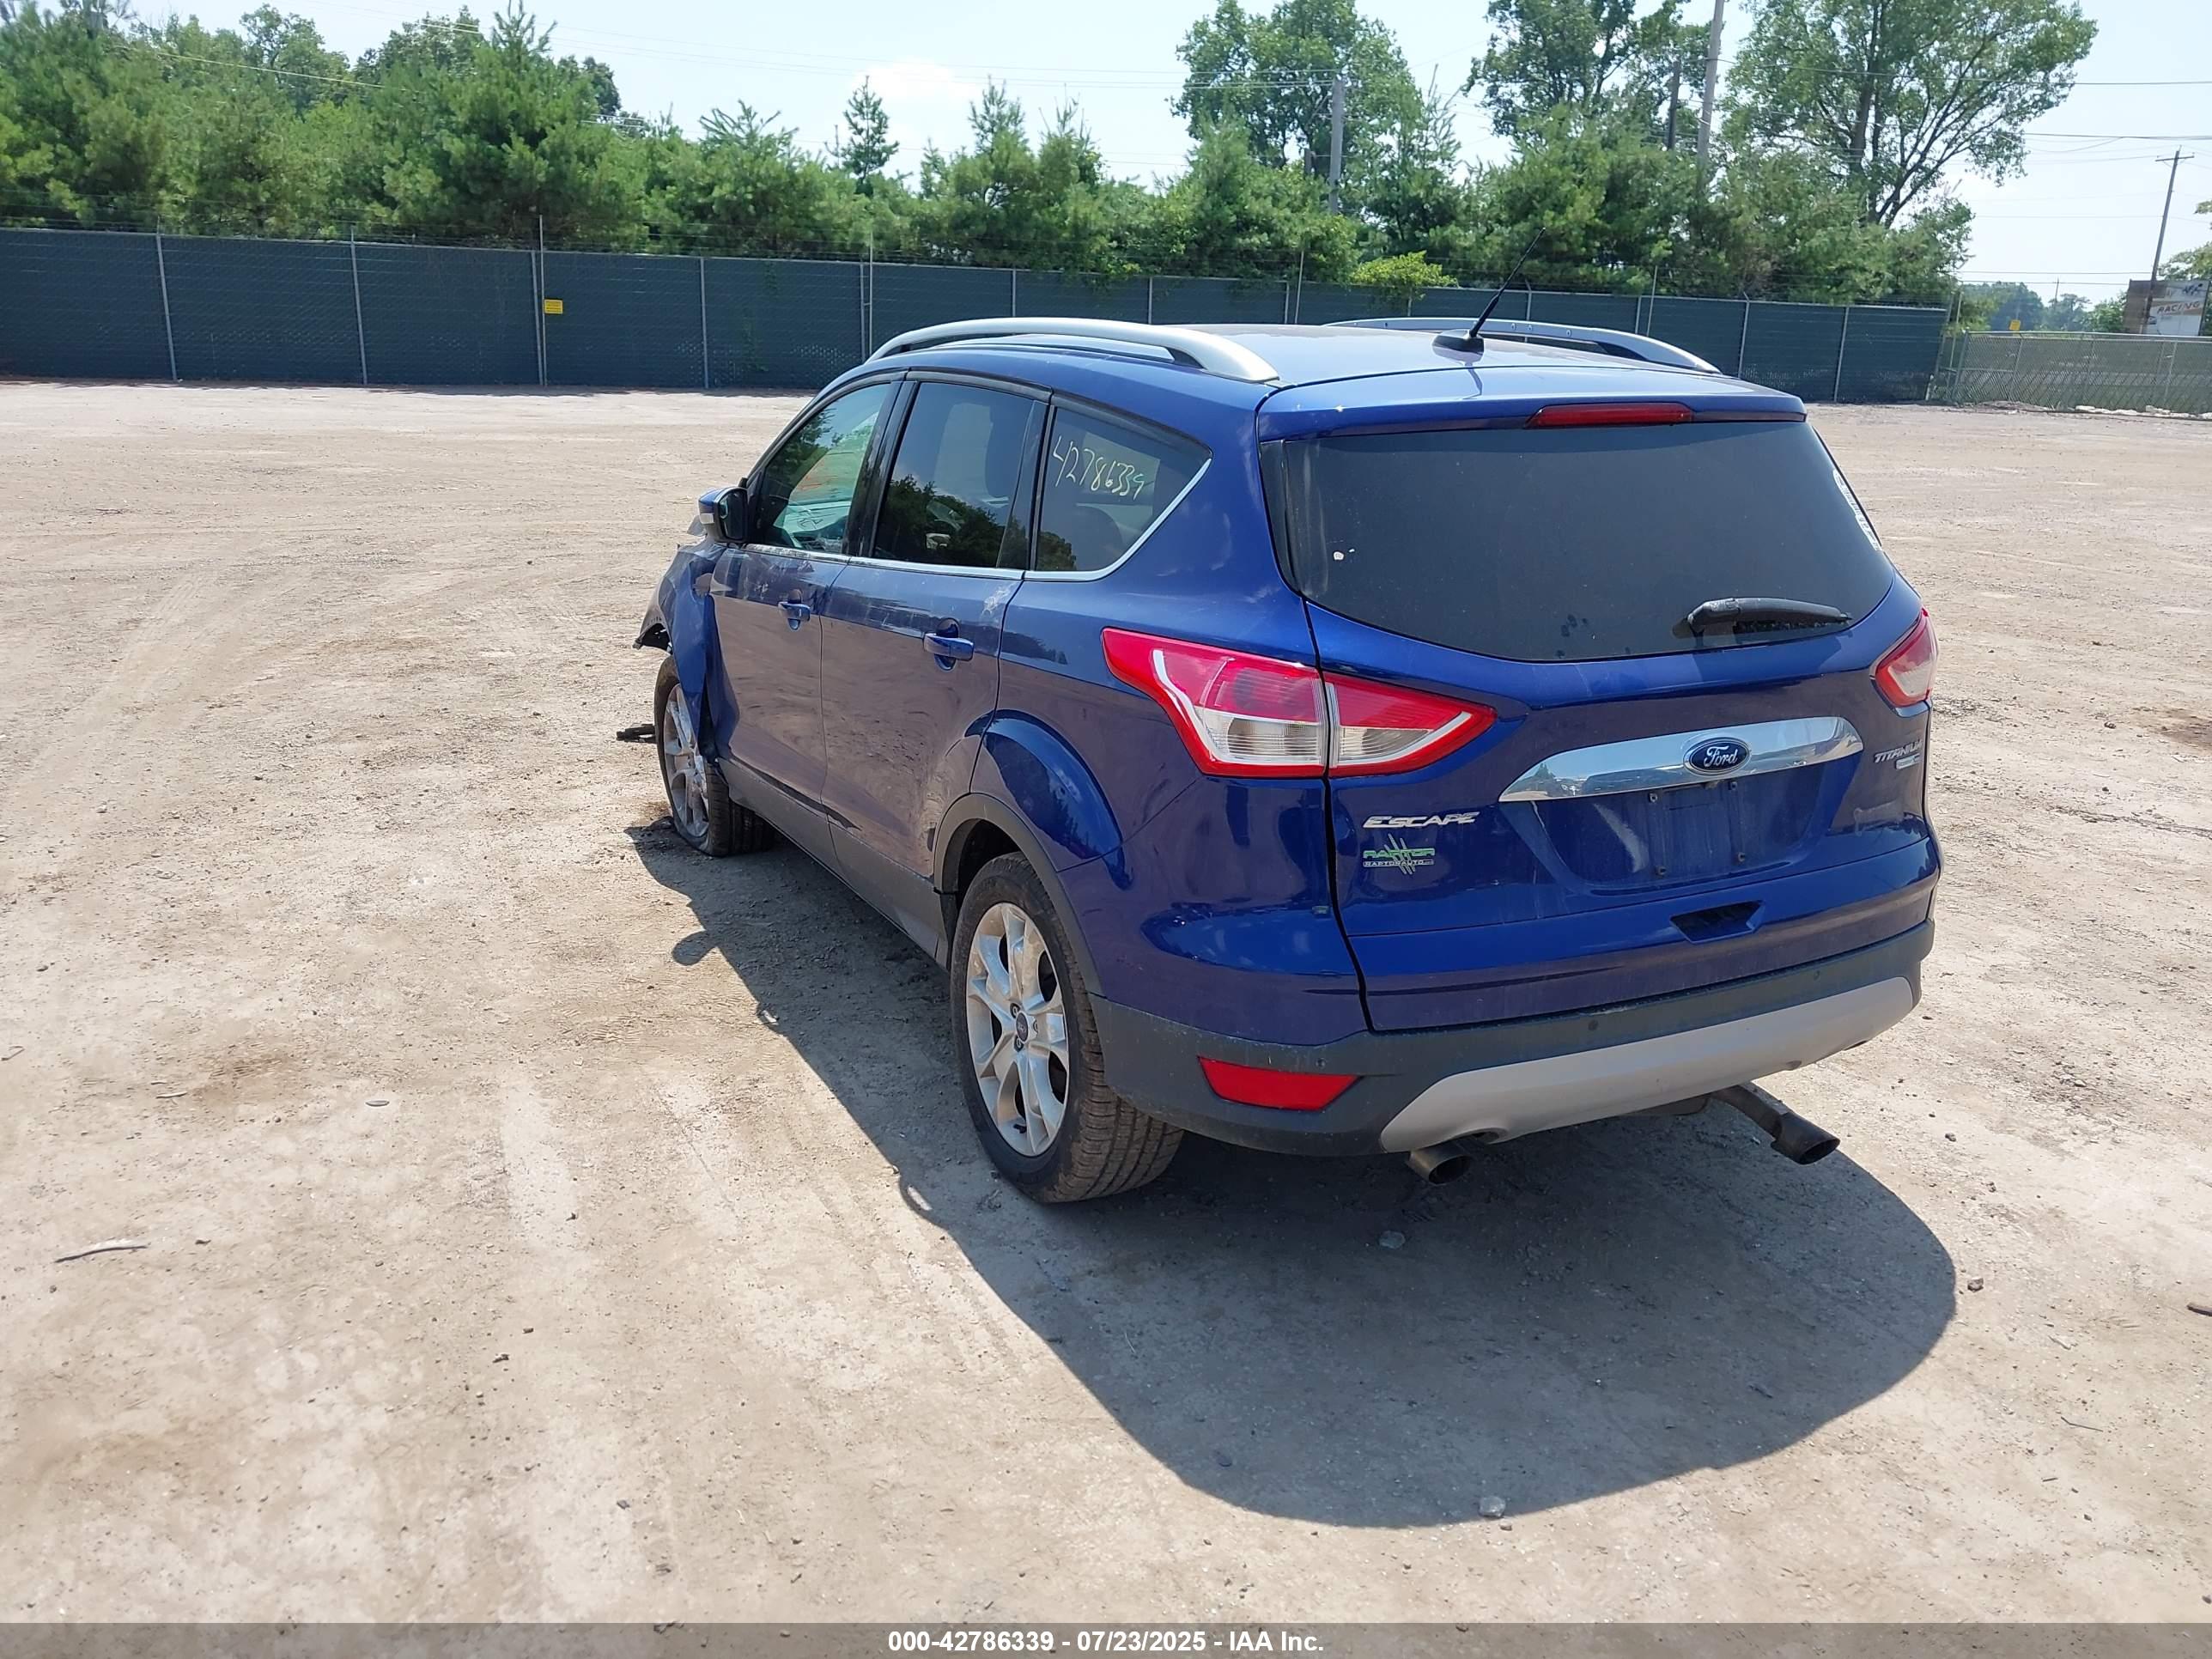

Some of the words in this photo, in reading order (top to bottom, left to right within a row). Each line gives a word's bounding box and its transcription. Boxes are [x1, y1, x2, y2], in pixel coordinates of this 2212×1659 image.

[2157, 301, 2200, 314] RACING
[1053, 435, 1146, 501] 42786339
[1704, 745, 1738, 768] Ford
[1874, 738, 1923, 763] TITANIUM
[1363, 811, 1480, 829] ESCAPE
